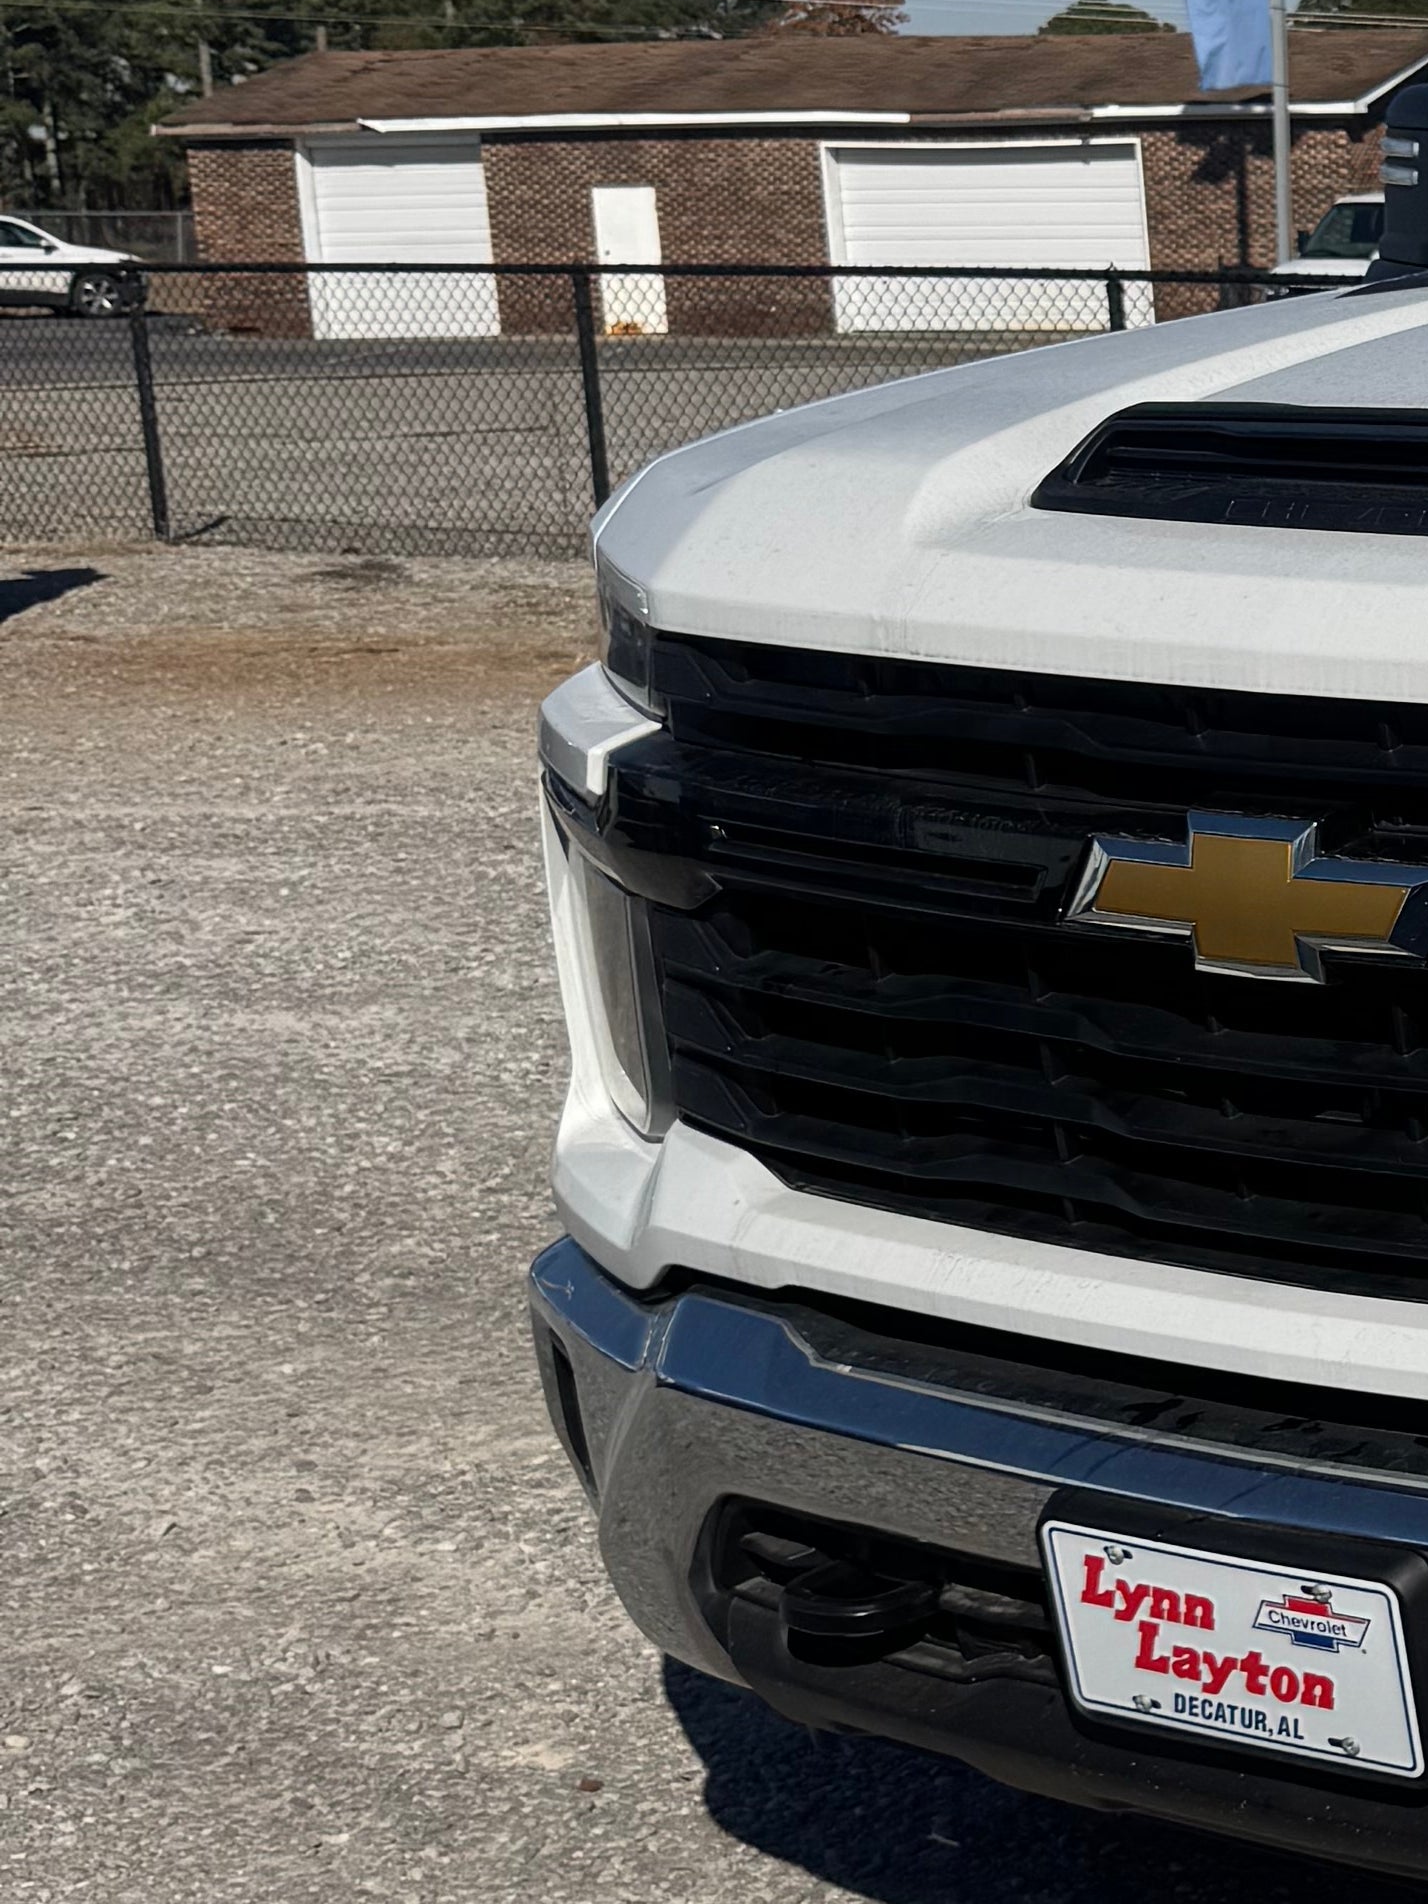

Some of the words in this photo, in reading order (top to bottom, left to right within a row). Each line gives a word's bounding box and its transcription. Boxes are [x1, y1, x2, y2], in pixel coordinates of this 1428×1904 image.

[1080, 1554, 1215, 1631] Lynn
[1268, 1609, 1347, 1637] Chevrolet
[1134, 1621, 1335, 1710] Layton
[1174, 1692, 1273, 1737] DECATUR,
[1277, 1715, 1304, 1740] AL
